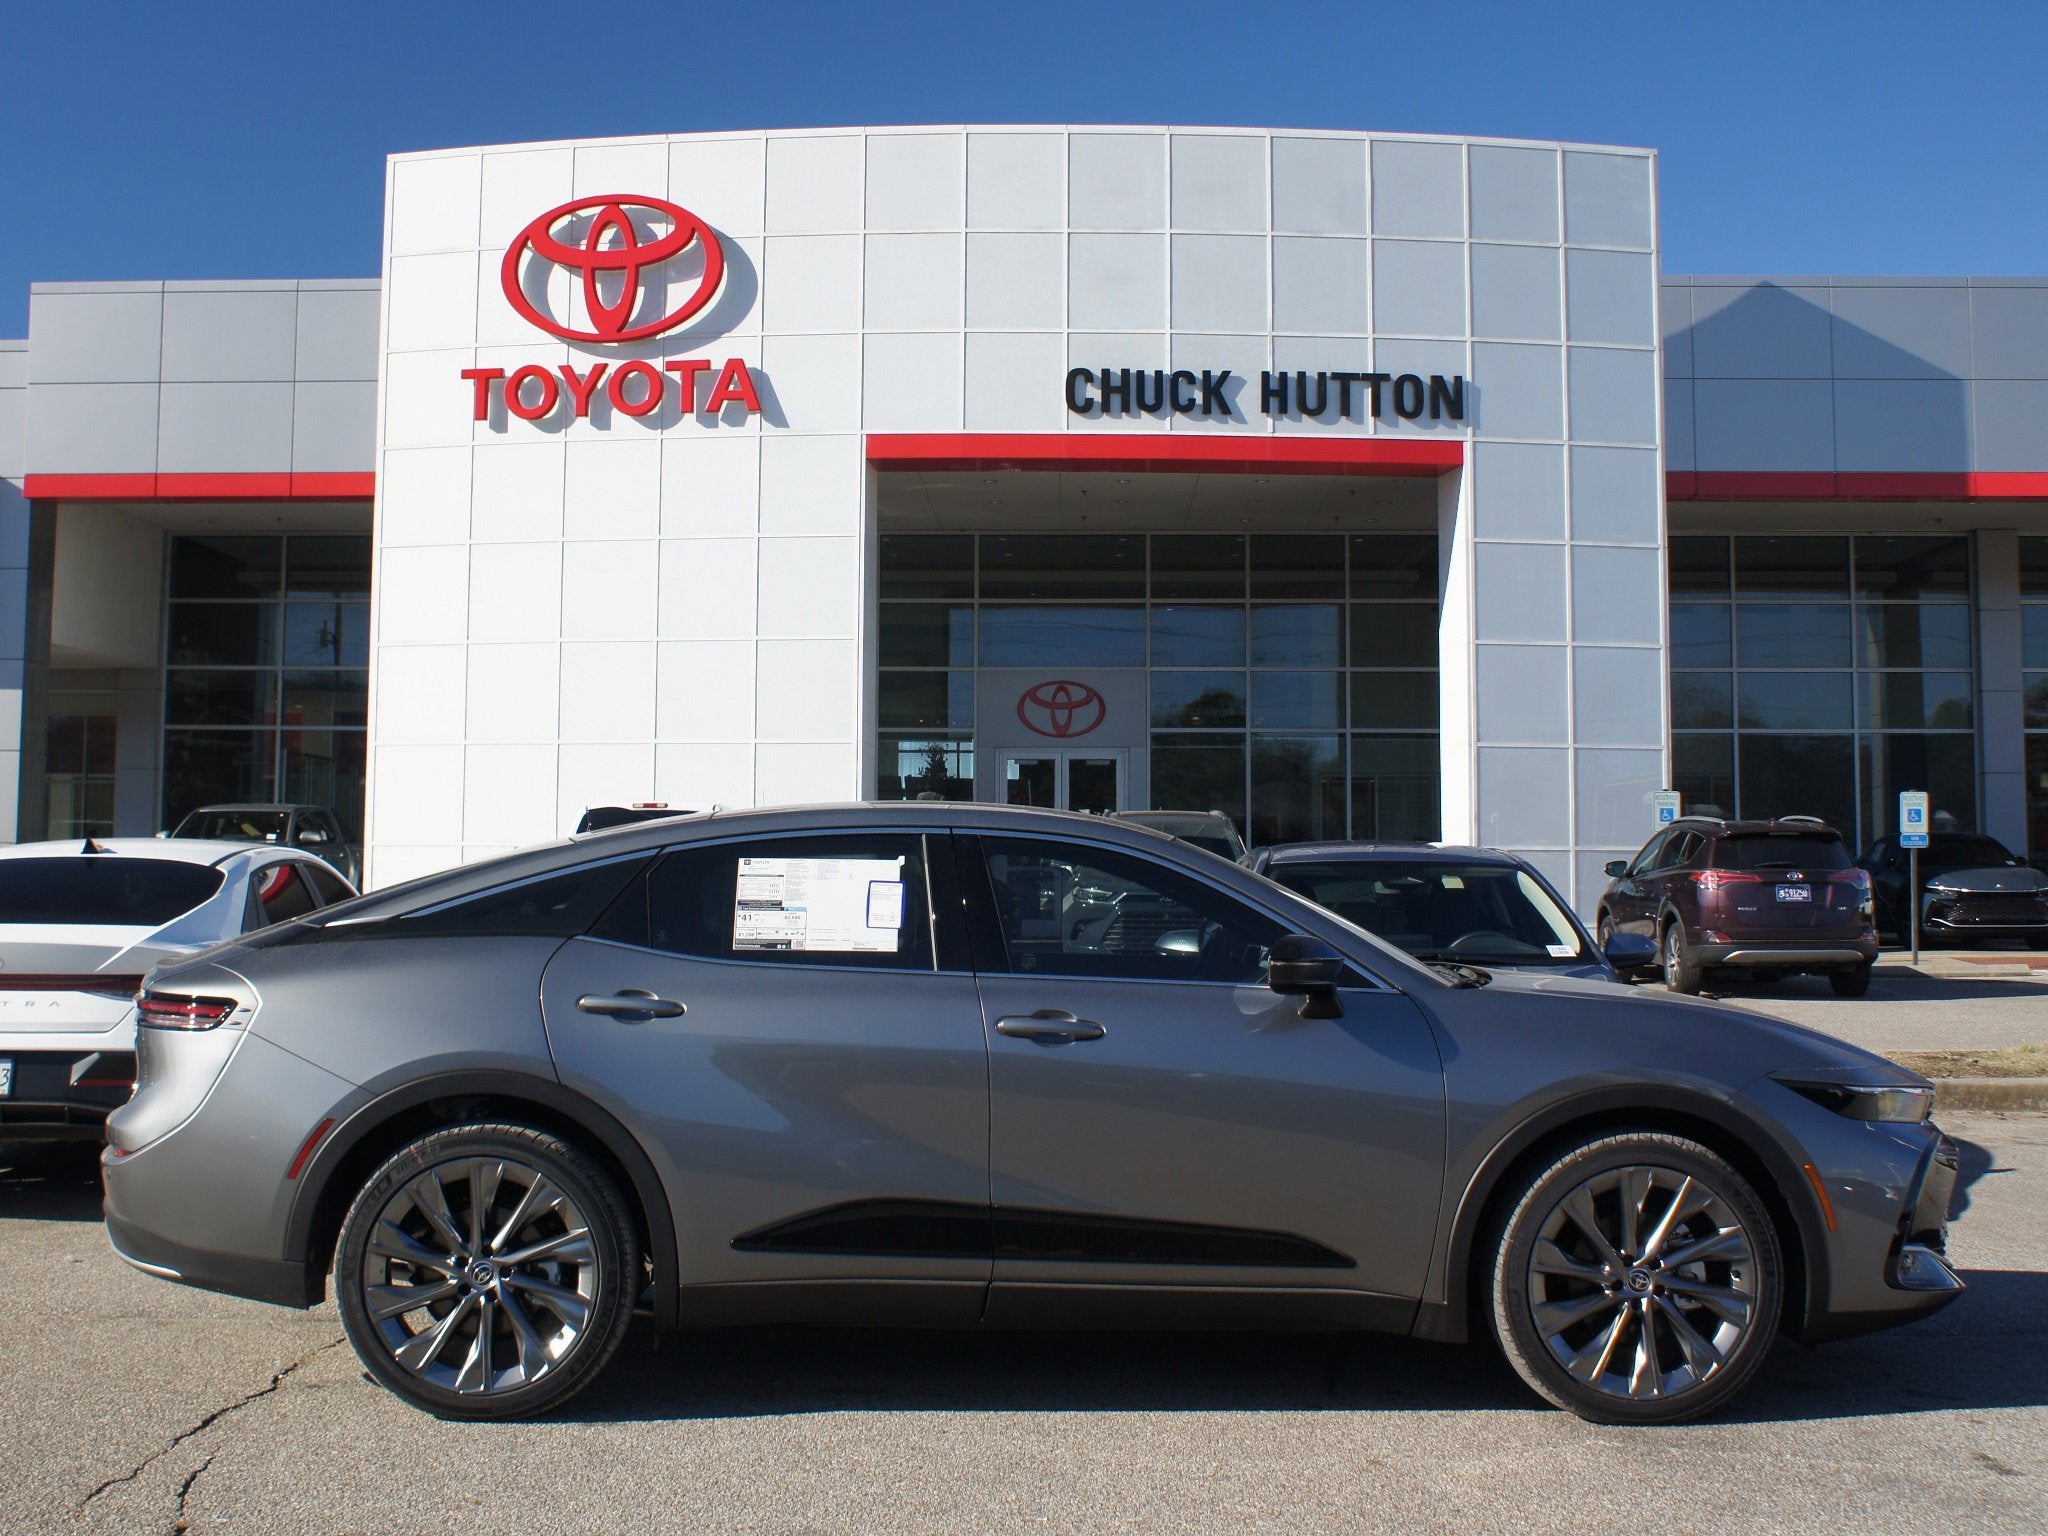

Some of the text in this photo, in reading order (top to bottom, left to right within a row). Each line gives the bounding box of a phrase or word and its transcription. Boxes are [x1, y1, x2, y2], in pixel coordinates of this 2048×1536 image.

[461, 358, 761, 421] TOYOTA
[1065, 367, 1464, 420] CHUCK HUTTON
